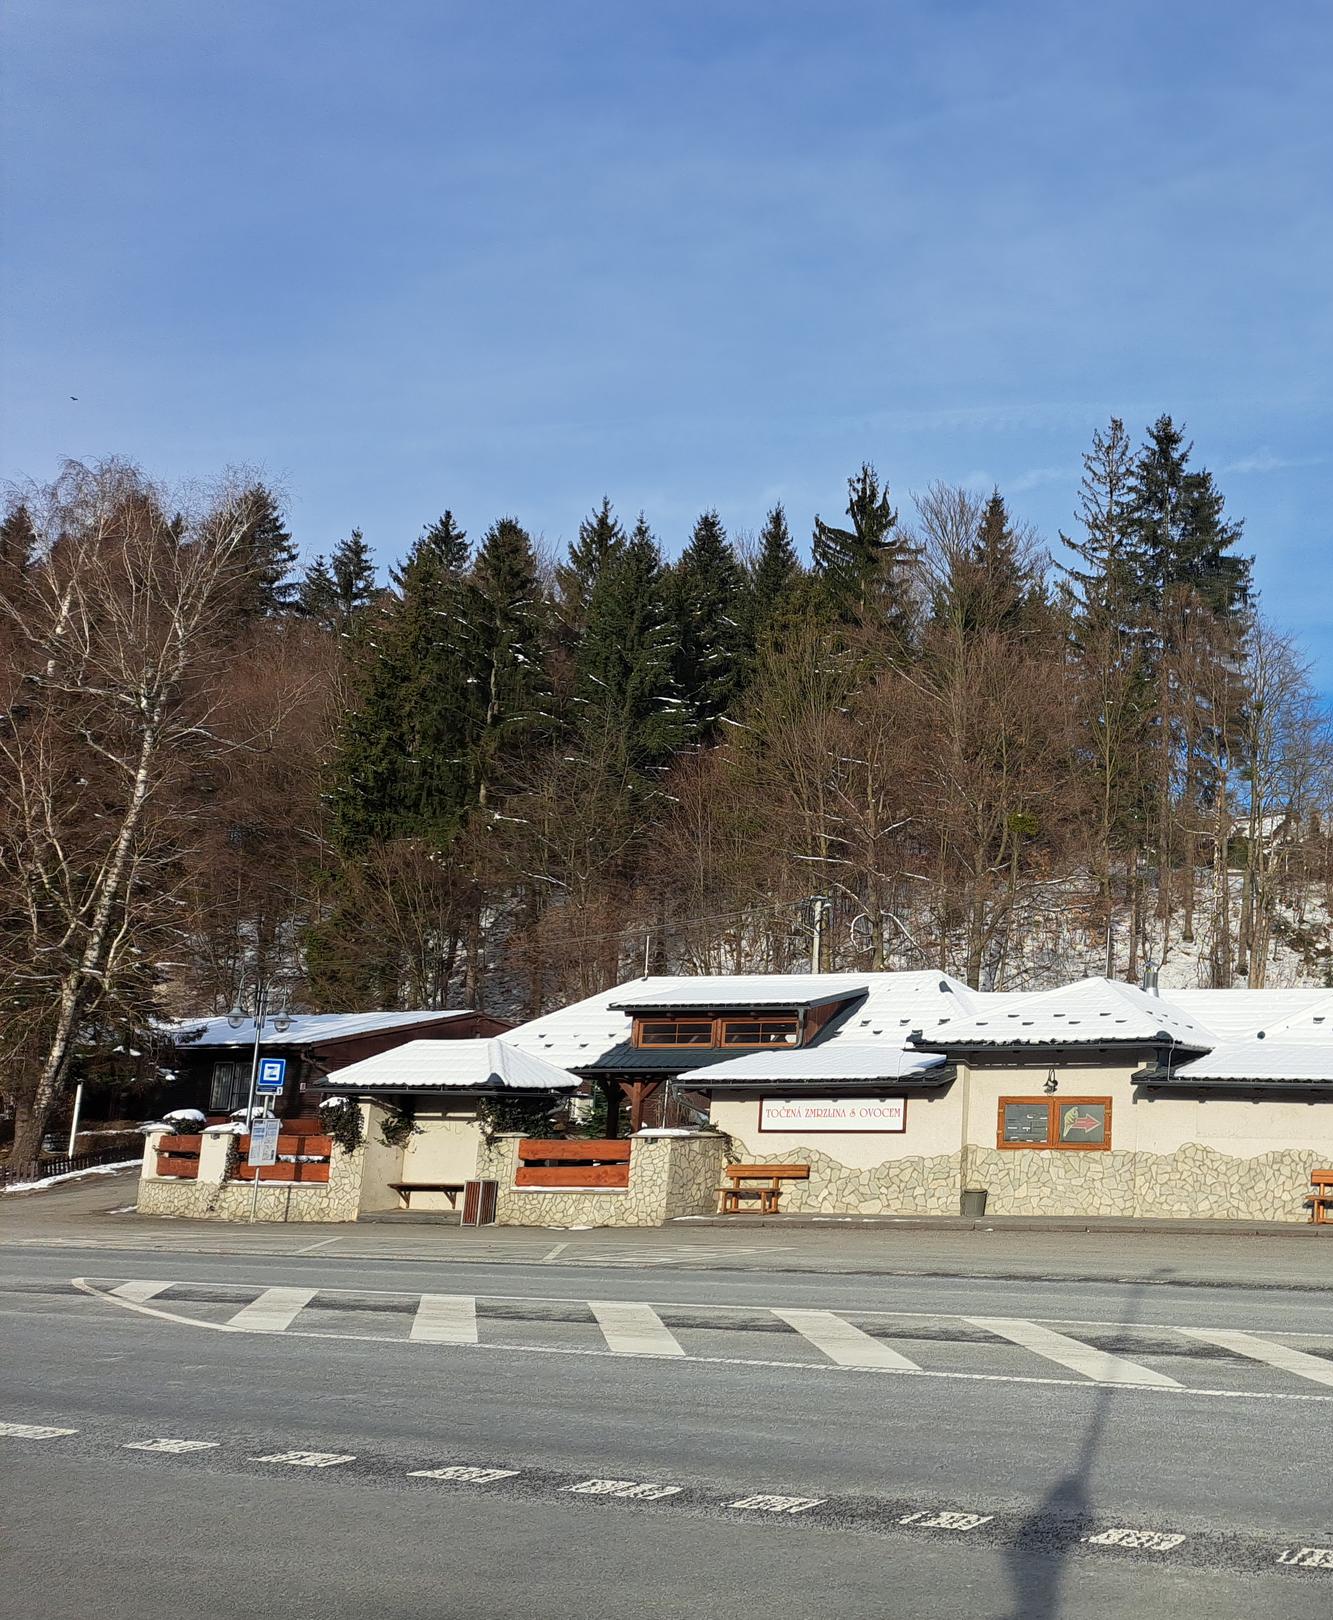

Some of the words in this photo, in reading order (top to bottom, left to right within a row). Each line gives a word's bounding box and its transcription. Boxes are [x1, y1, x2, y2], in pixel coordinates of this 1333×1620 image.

[766, 1106, 802, 1118] TOČENÁ
[805, 1107, 846, 1118] ZMRZLINA
[860, 1108, 901, 1118] OVOCEM
